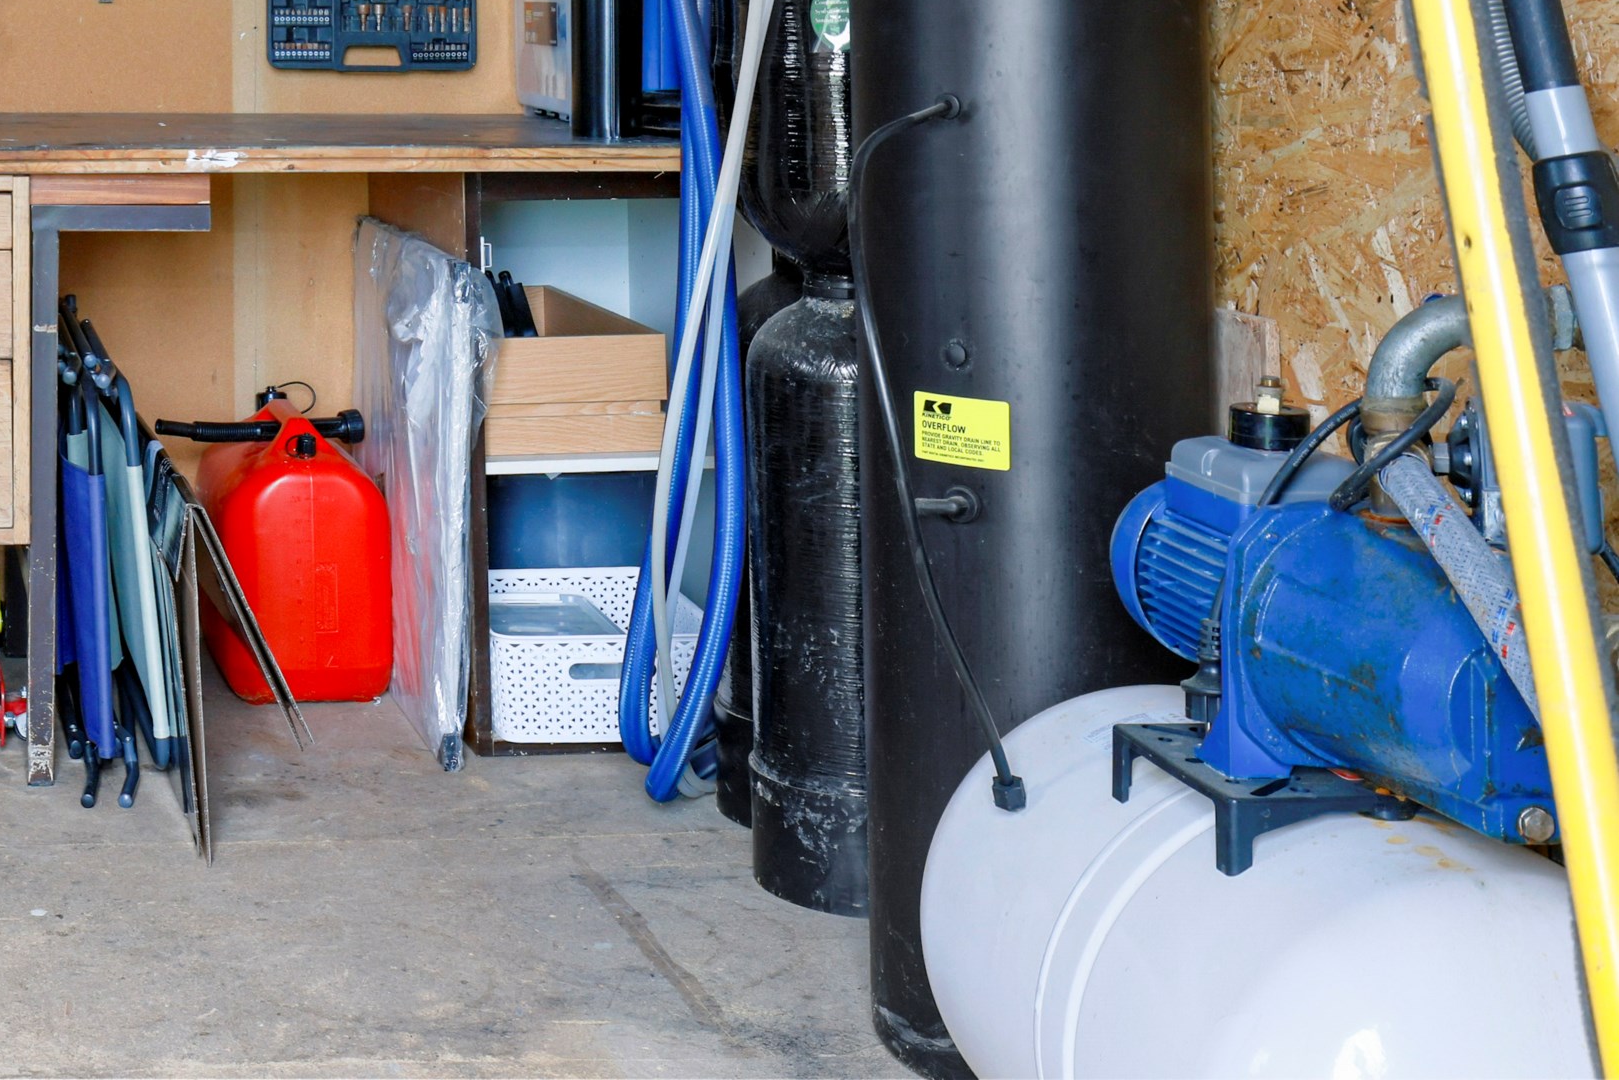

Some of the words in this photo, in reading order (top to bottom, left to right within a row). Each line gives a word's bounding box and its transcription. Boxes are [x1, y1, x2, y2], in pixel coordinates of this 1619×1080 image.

[922, 412, 951, 420] KINETICO
[922, 420, 966, 433] OVERFLOW
[922, 430, 940, 438] PROVIDE
[922, 436, 941, 444] NEAREST
[961, 442, 990, 451] OBSERVING
